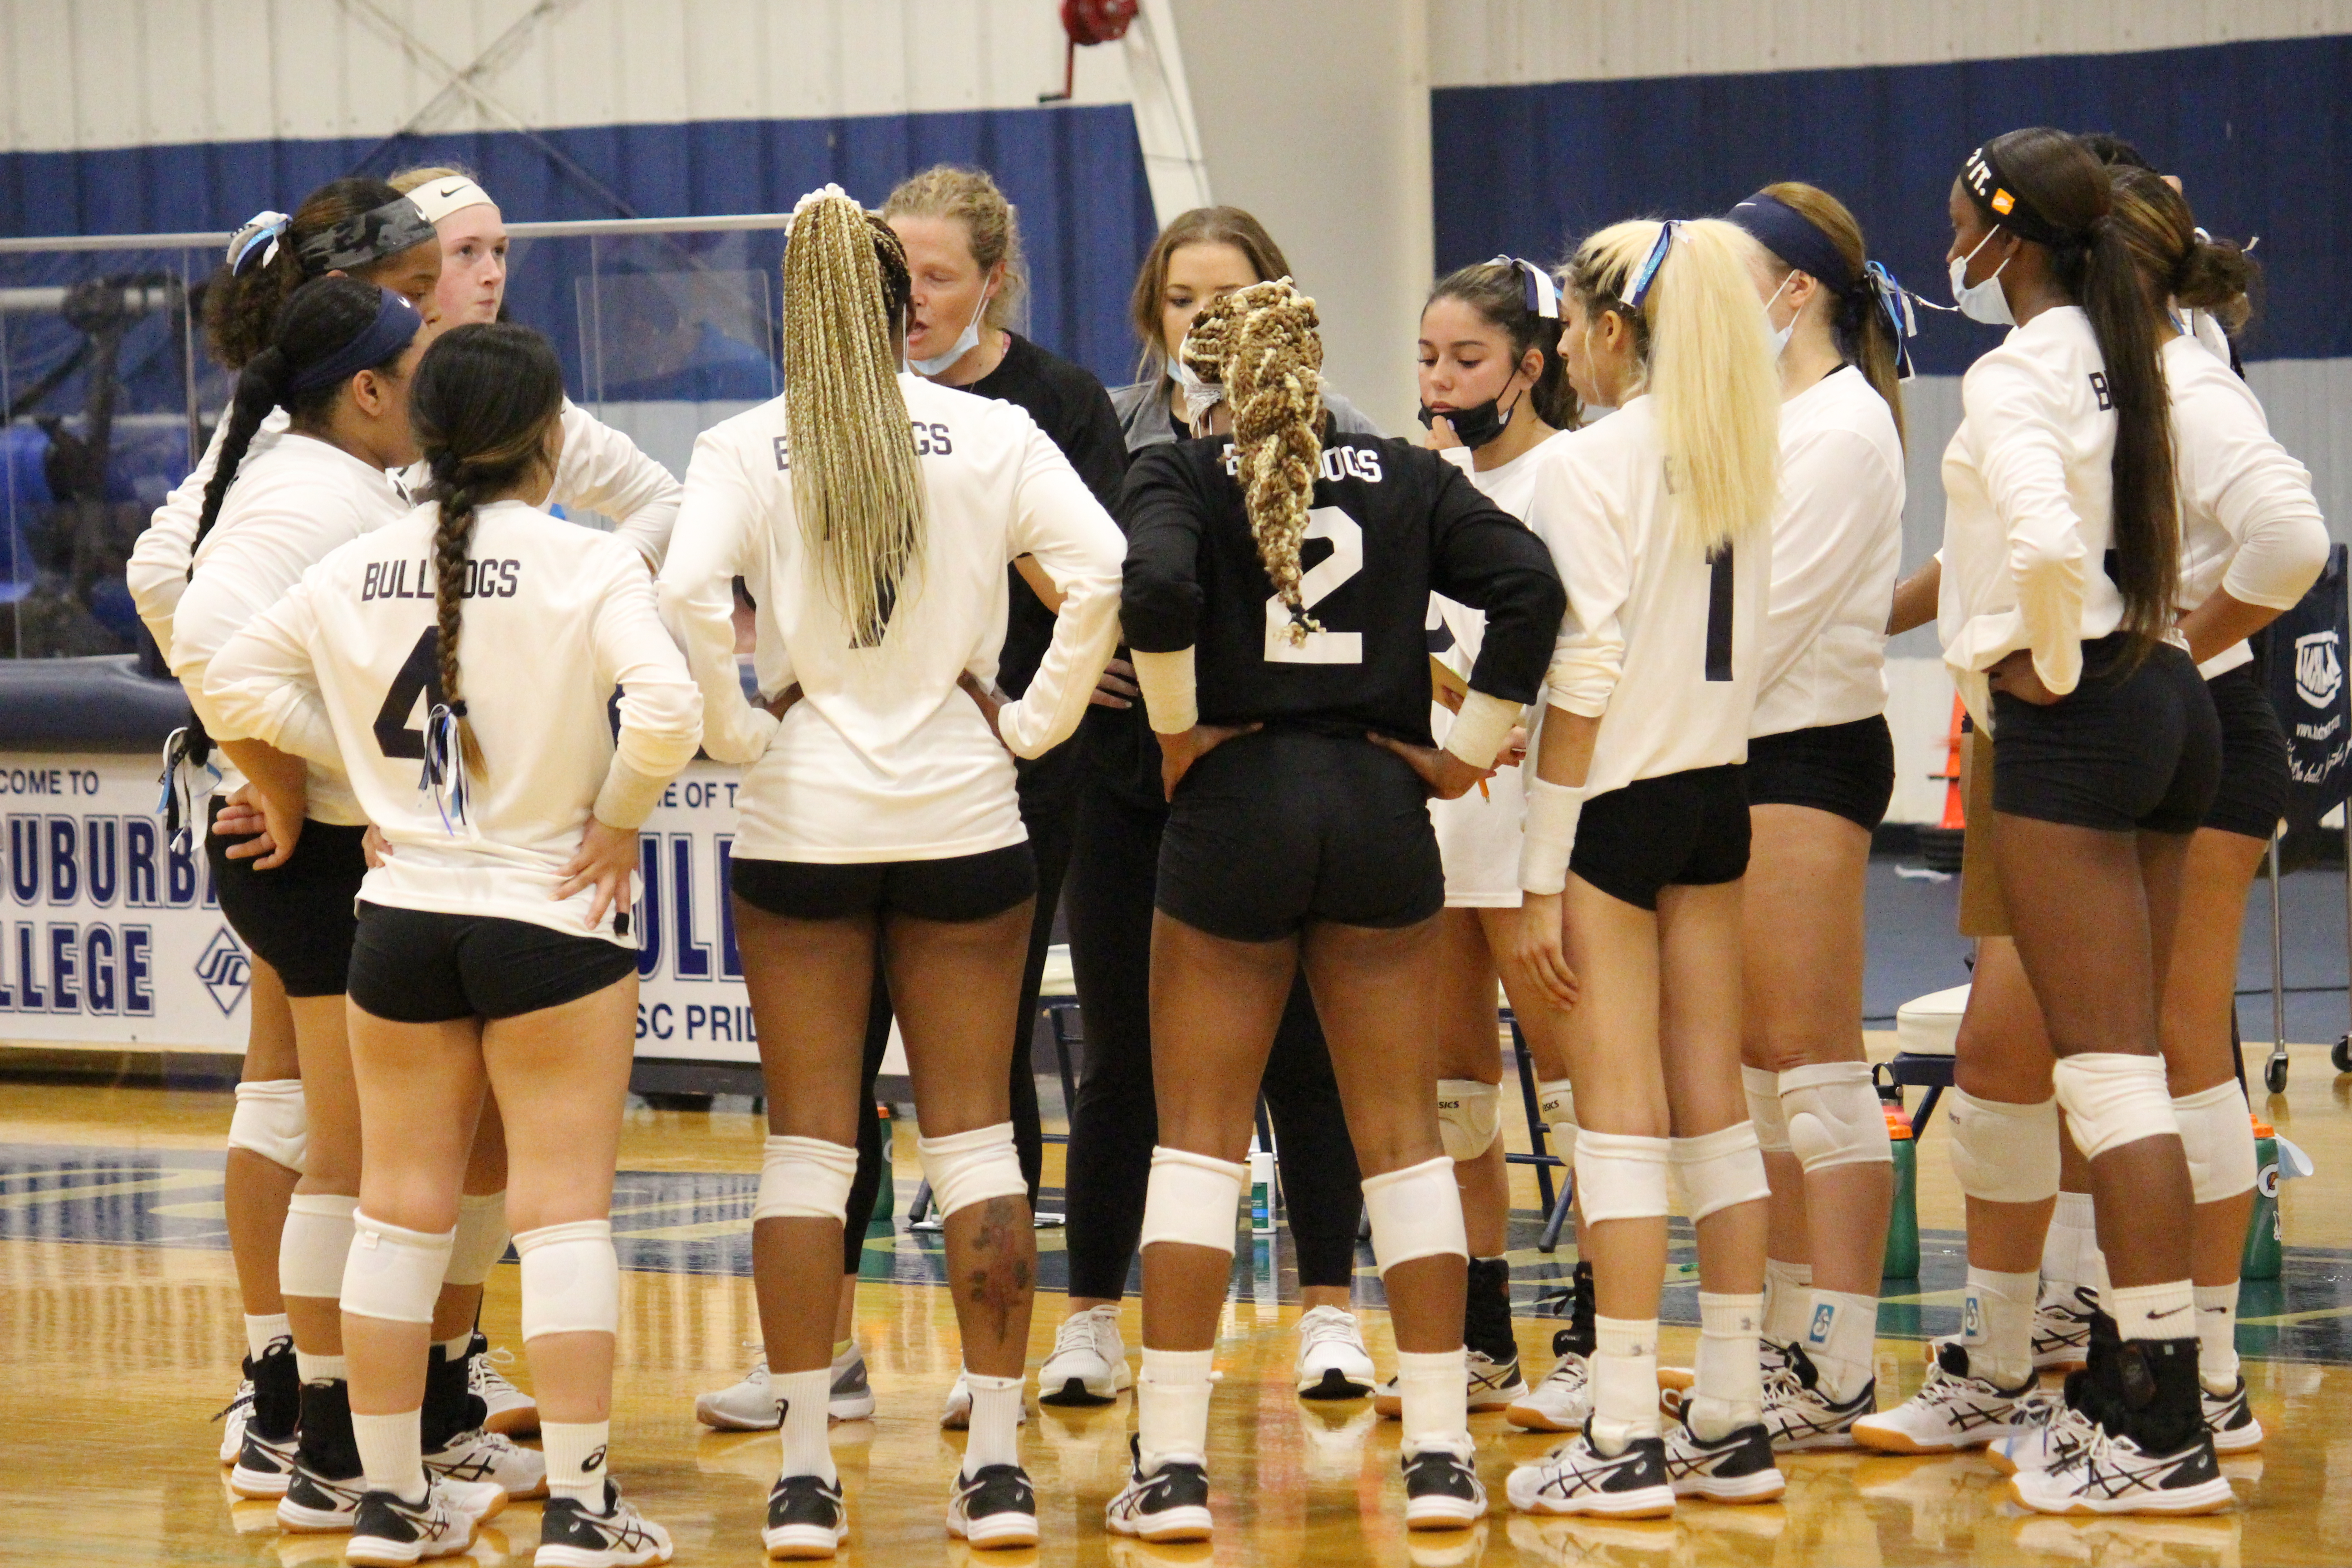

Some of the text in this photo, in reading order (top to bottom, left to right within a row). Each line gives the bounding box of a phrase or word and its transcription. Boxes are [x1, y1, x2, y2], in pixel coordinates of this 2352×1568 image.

[362, 559, 520, 601] BULLOGS
[1264, 505, 1362, 664] 2
[69, 770, 99, 795] TO
[685, 782, 717, 808] OF
